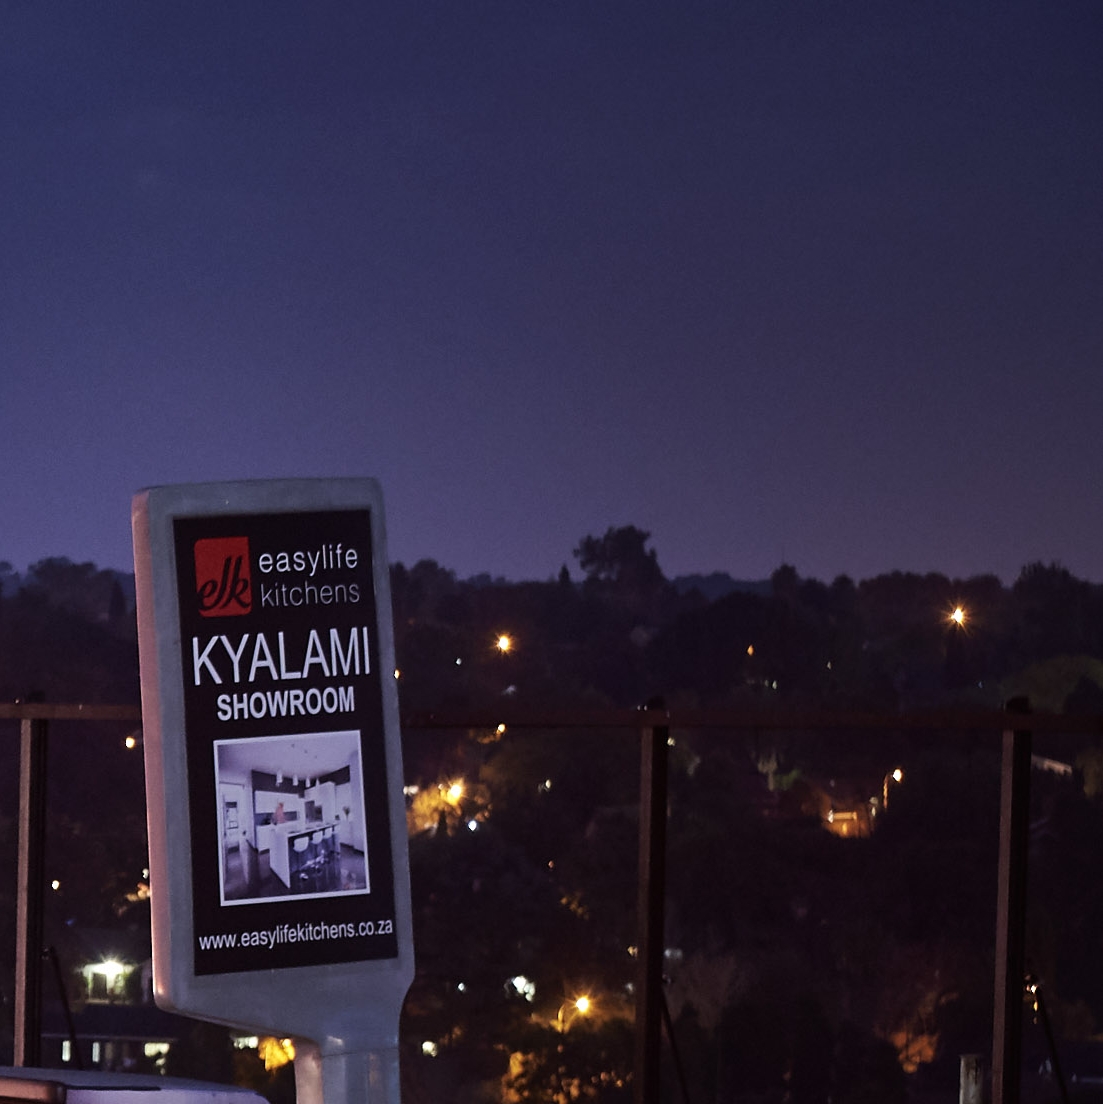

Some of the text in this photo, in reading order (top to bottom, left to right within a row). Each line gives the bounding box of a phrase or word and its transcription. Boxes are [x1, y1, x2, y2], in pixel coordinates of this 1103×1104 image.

[258, 543, 358, 577] easylife
[260, 580, 360, 608] kitchens
[192, 626, 371, 686] KYALAMI
[216, 686, 355, 721] SHOWROOM
[198, 919, 394, 950] www.easylifekitchens.co.za
